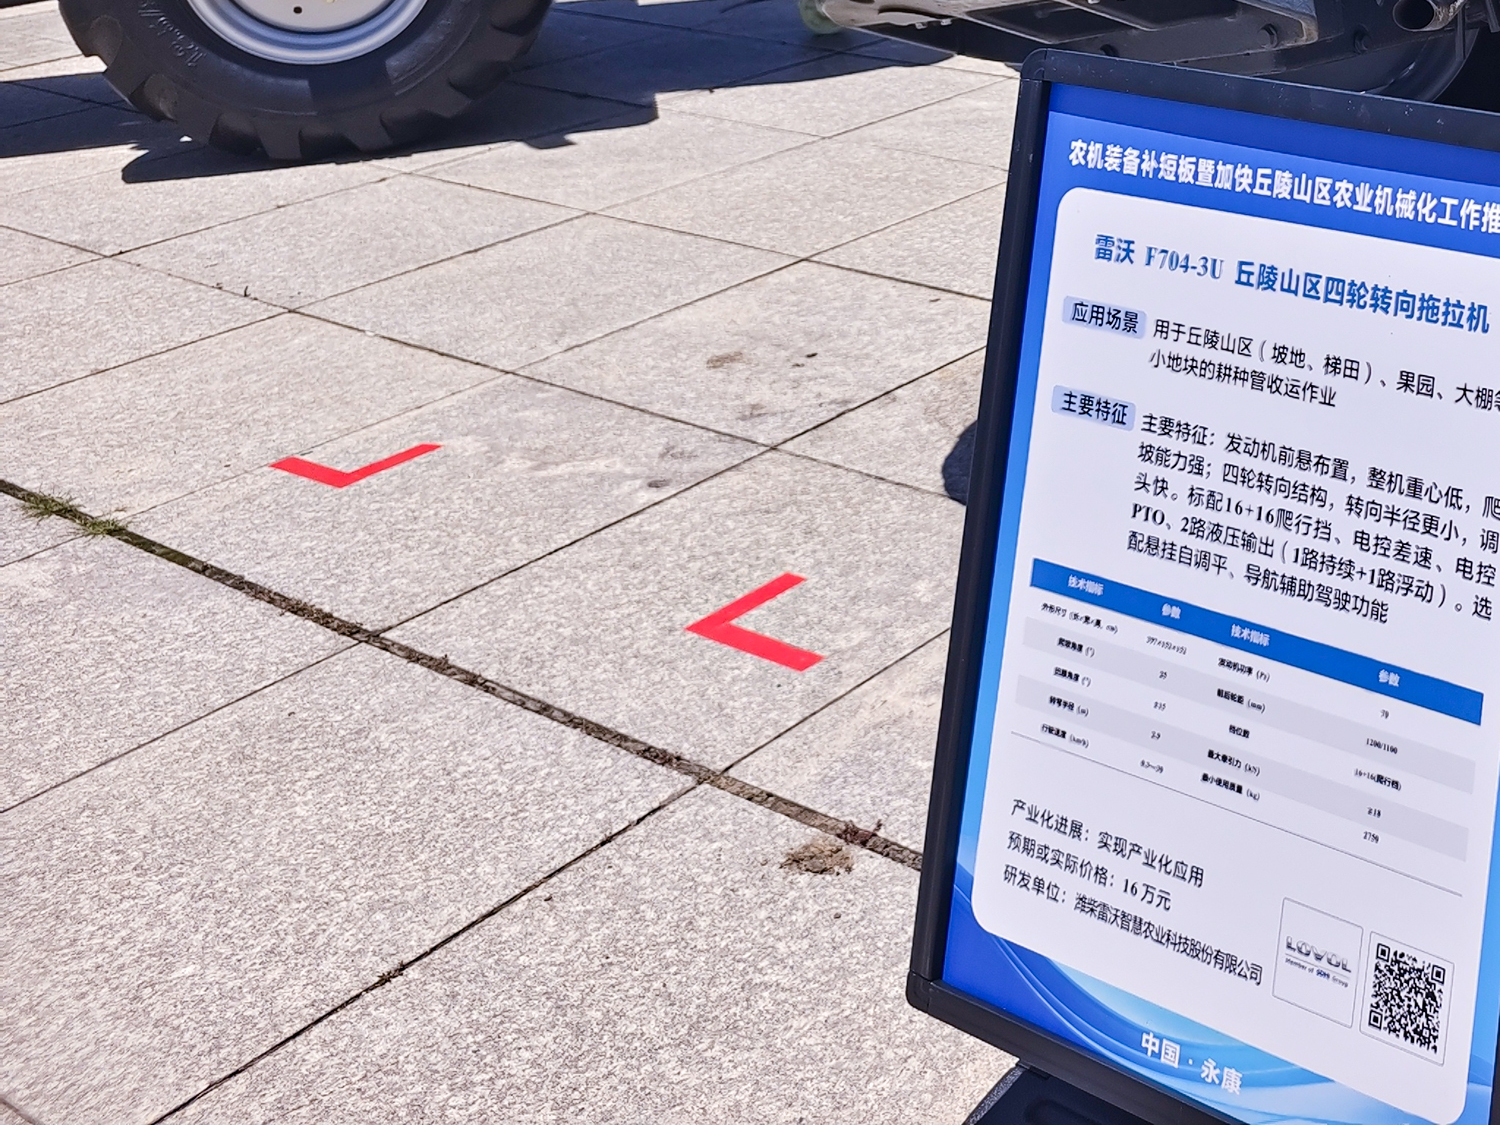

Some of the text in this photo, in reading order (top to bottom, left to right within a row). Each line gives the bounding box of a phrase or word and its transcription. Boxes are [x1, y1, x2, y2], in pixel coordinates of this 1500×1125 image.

[1094, 234, 1491, 334] 雷沃 F704-3U 丘陵山区四轮转向拖拉机
[1070, 302, 1139, 335] 应用场景
[1149, 349, 1337, 408] 小地块的耕种管收运作业
[1062, 391, 1129, 426] 主要特征
[1067, 575, 1104, 596] 技术指标
[1231, 624, 1271, 647] 技术指标
[1285, 935, 1353, 974] LOVOL
